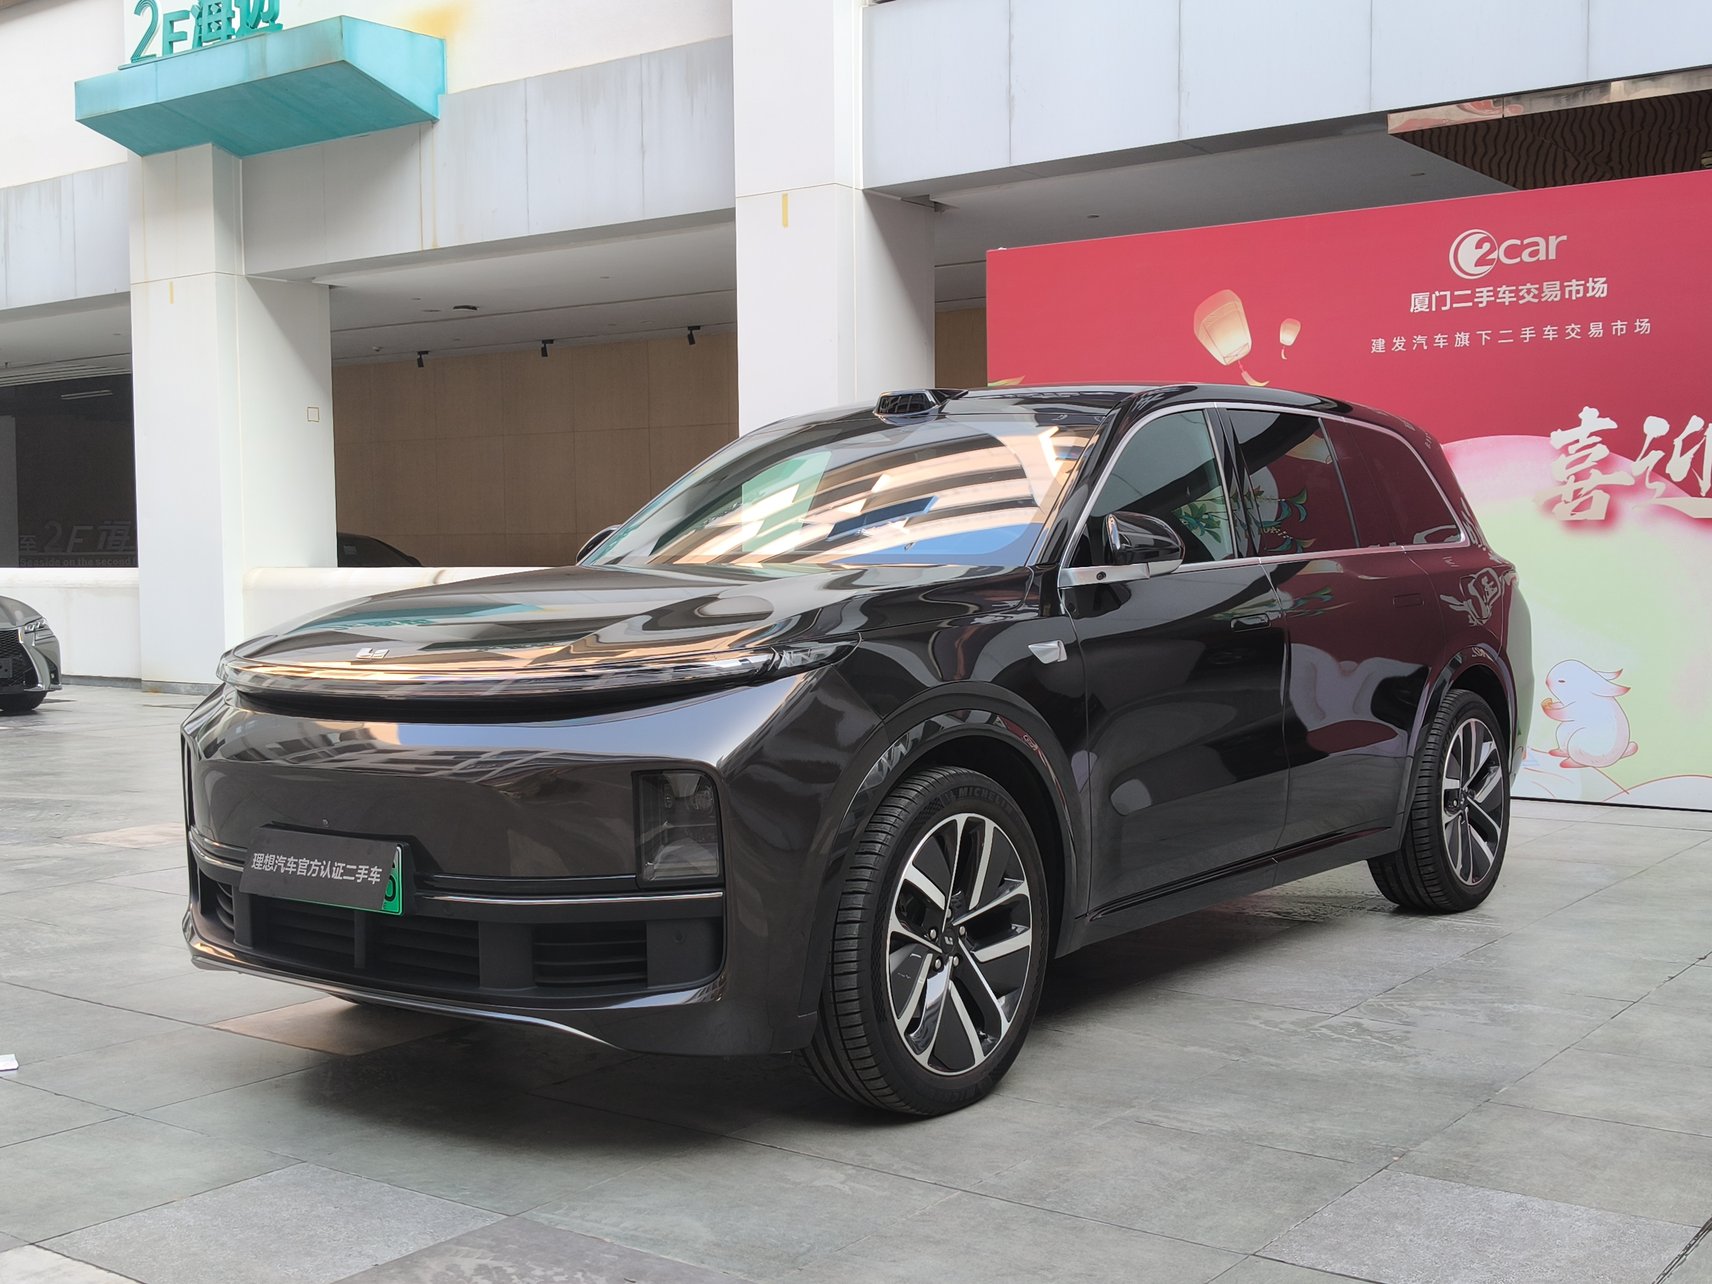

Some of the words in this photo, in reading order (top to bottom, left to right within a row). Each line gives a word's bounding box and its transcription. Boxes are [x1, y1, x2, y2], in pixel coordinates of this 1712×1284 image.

[1410, 277, 1608, 313] 厦门二手车交易市场
[1371, 318, 1651, 353] 建发汽车旗下二手车交易市场
[78, 557, 93, 566] the
[95, 557, 131, 566] second
[251, 853, 382, 885] 理想汽车官方认证二手车
